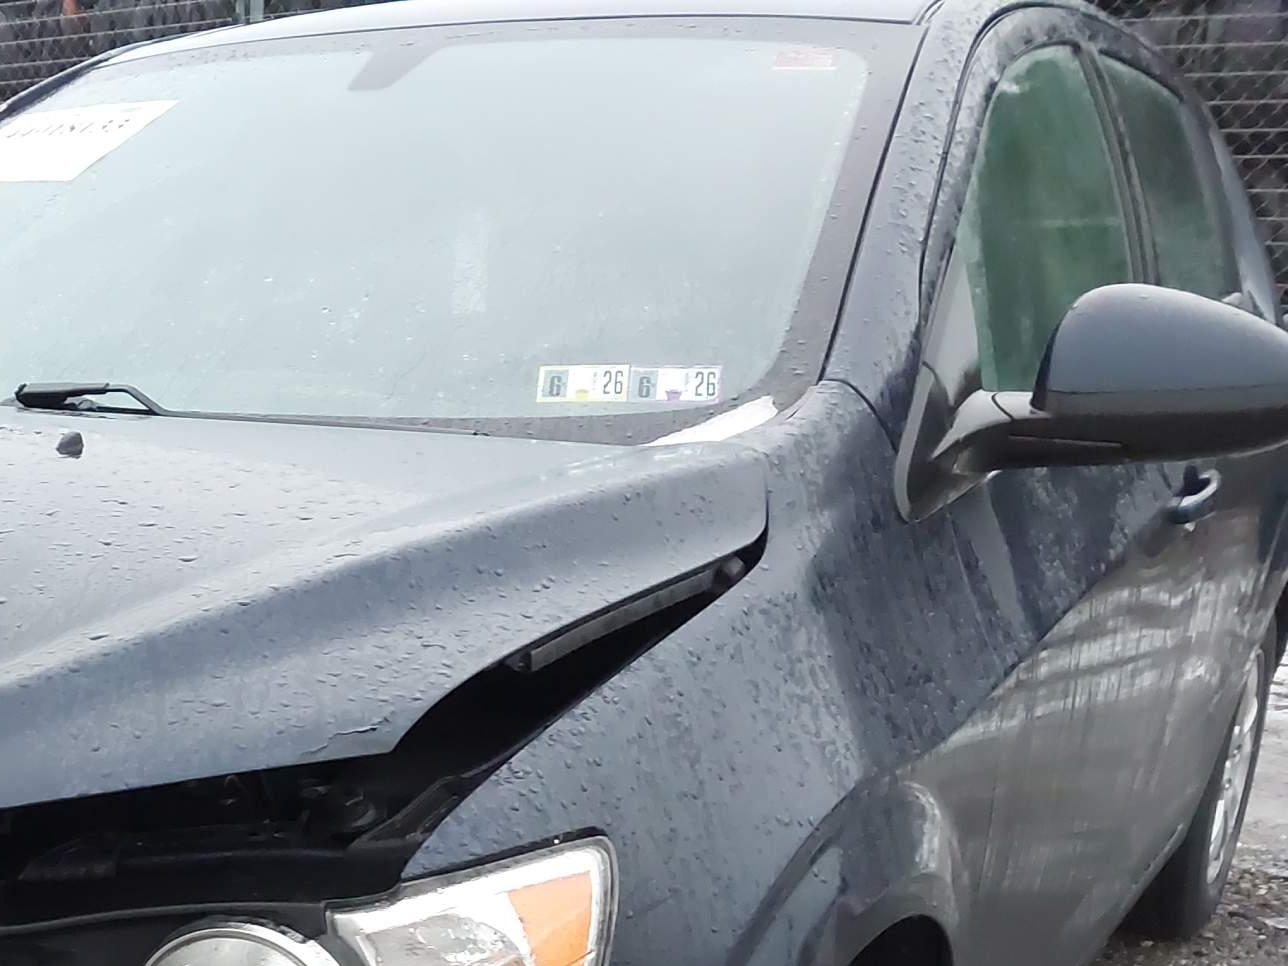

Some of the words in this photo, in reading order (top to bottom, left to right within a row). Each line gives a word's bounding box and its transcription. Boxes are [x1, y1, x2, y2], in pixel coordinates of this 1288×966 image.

[549, 375, 562, 397] 6
[603, 370, 625, 395] 26
[638, 376, 652, 398] 6
[695, 371, 717, 397] 26
